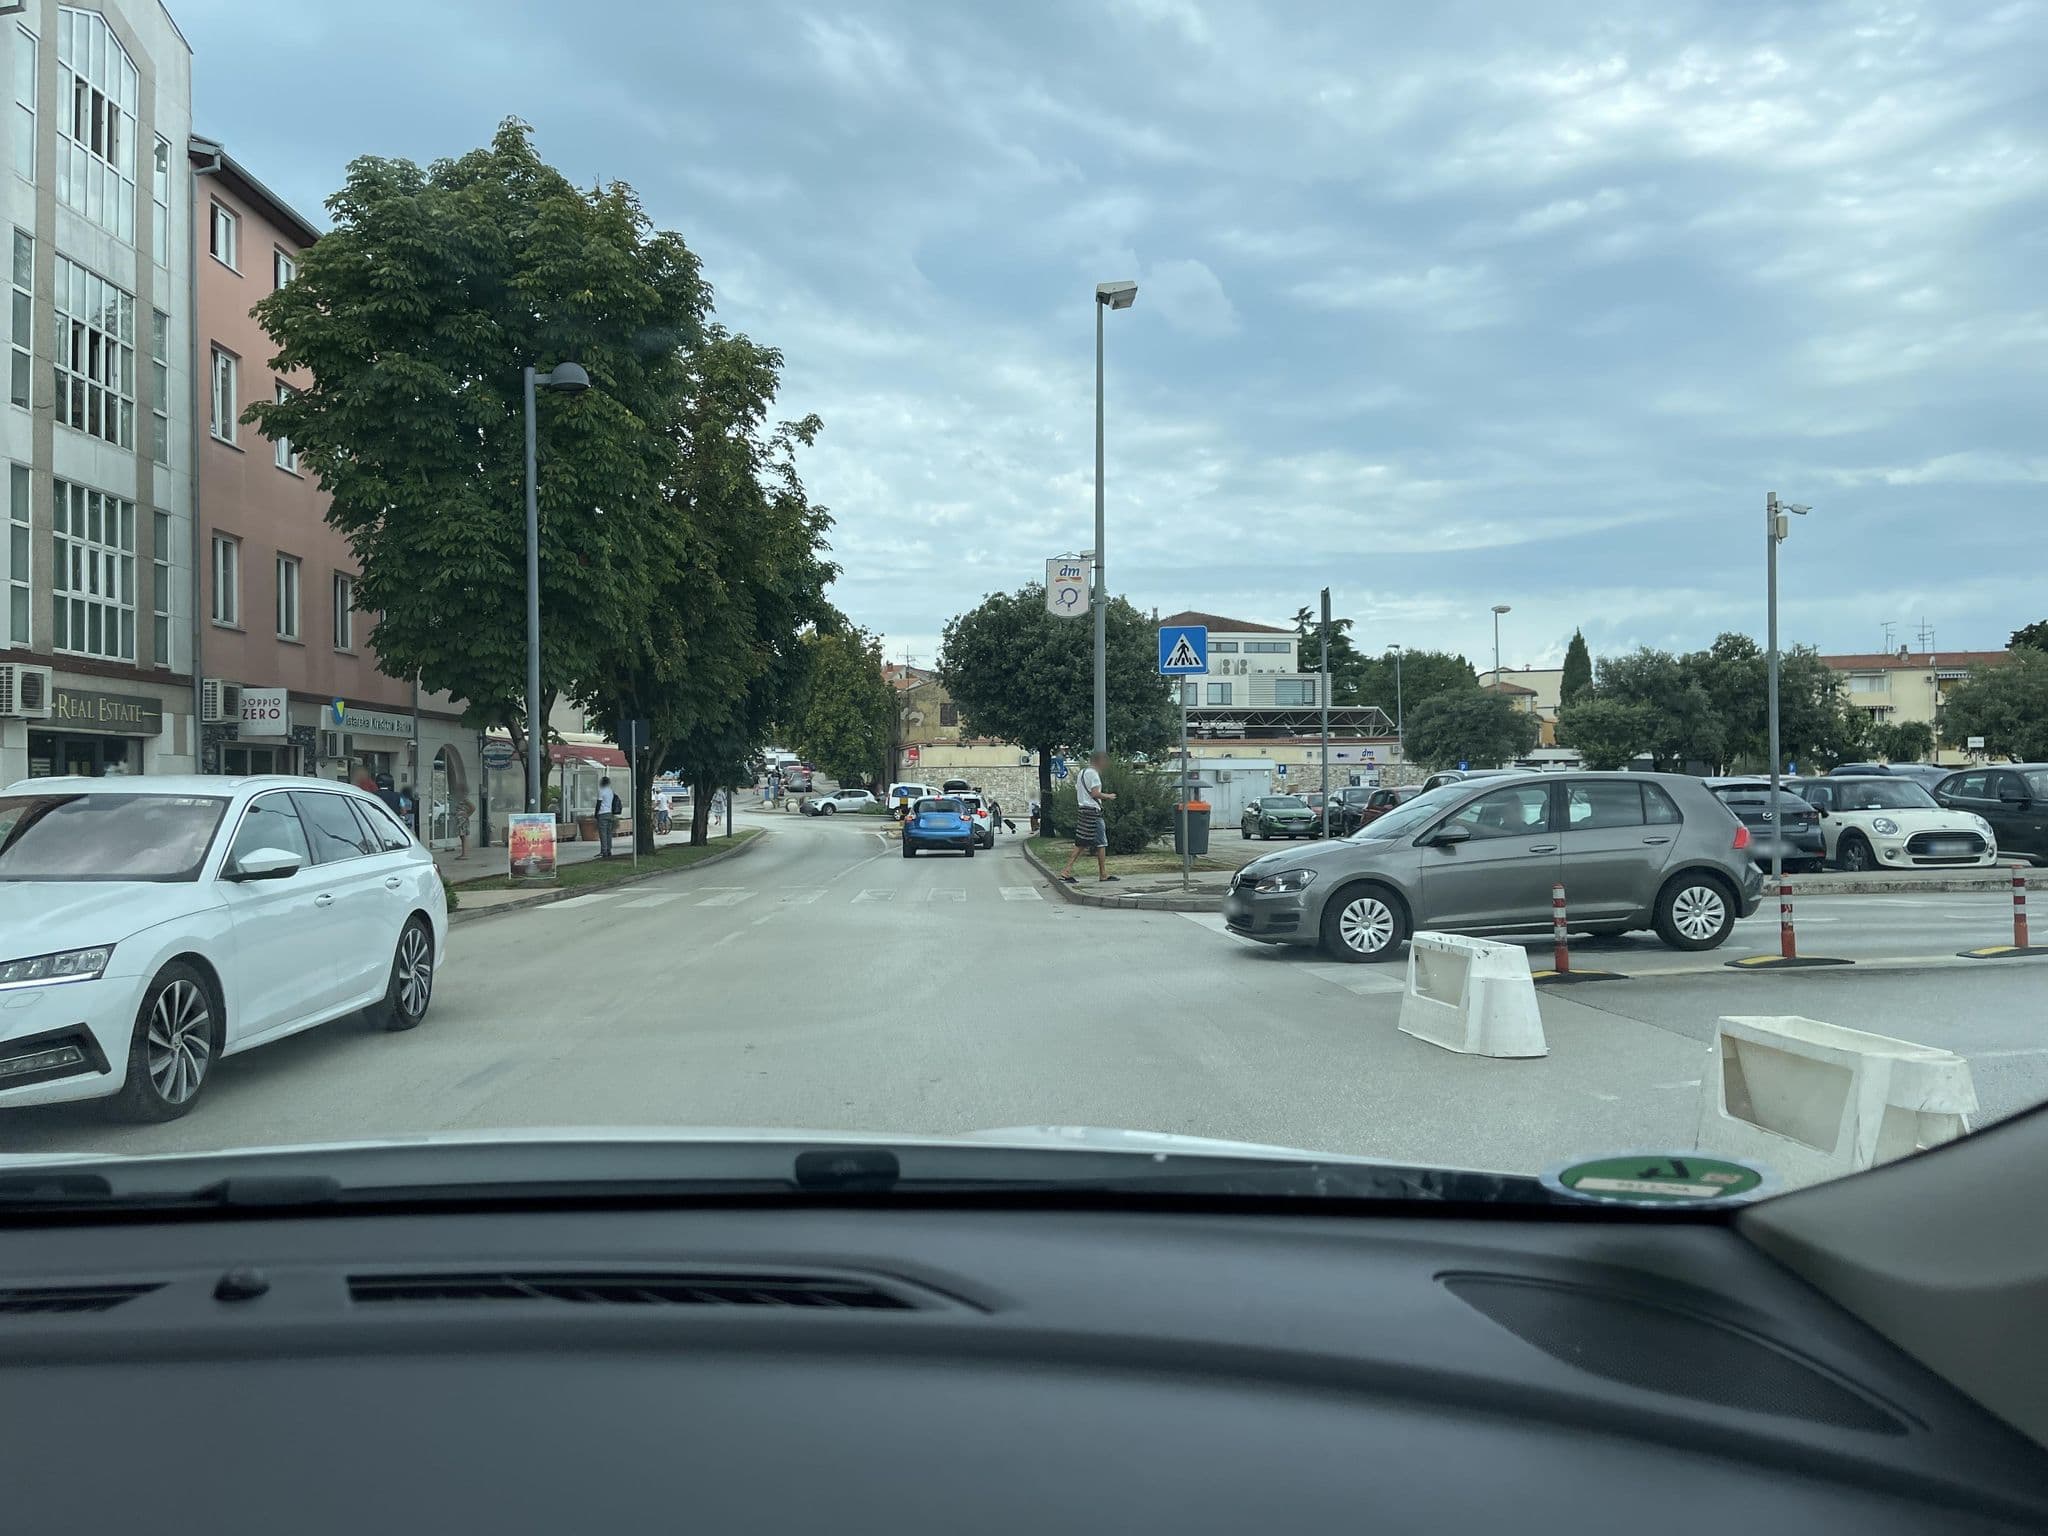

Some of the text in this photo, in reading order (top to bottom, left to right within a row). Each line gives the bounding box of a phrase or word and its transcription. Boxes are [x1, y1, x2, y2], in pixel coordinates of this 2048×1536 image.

[1060, 565, 1080, 577] dm
[240, 697, 281, 707] DOPPIO
[240, 708, 280, 720] ZERO
[1361, 749, 1374, 758] dm
